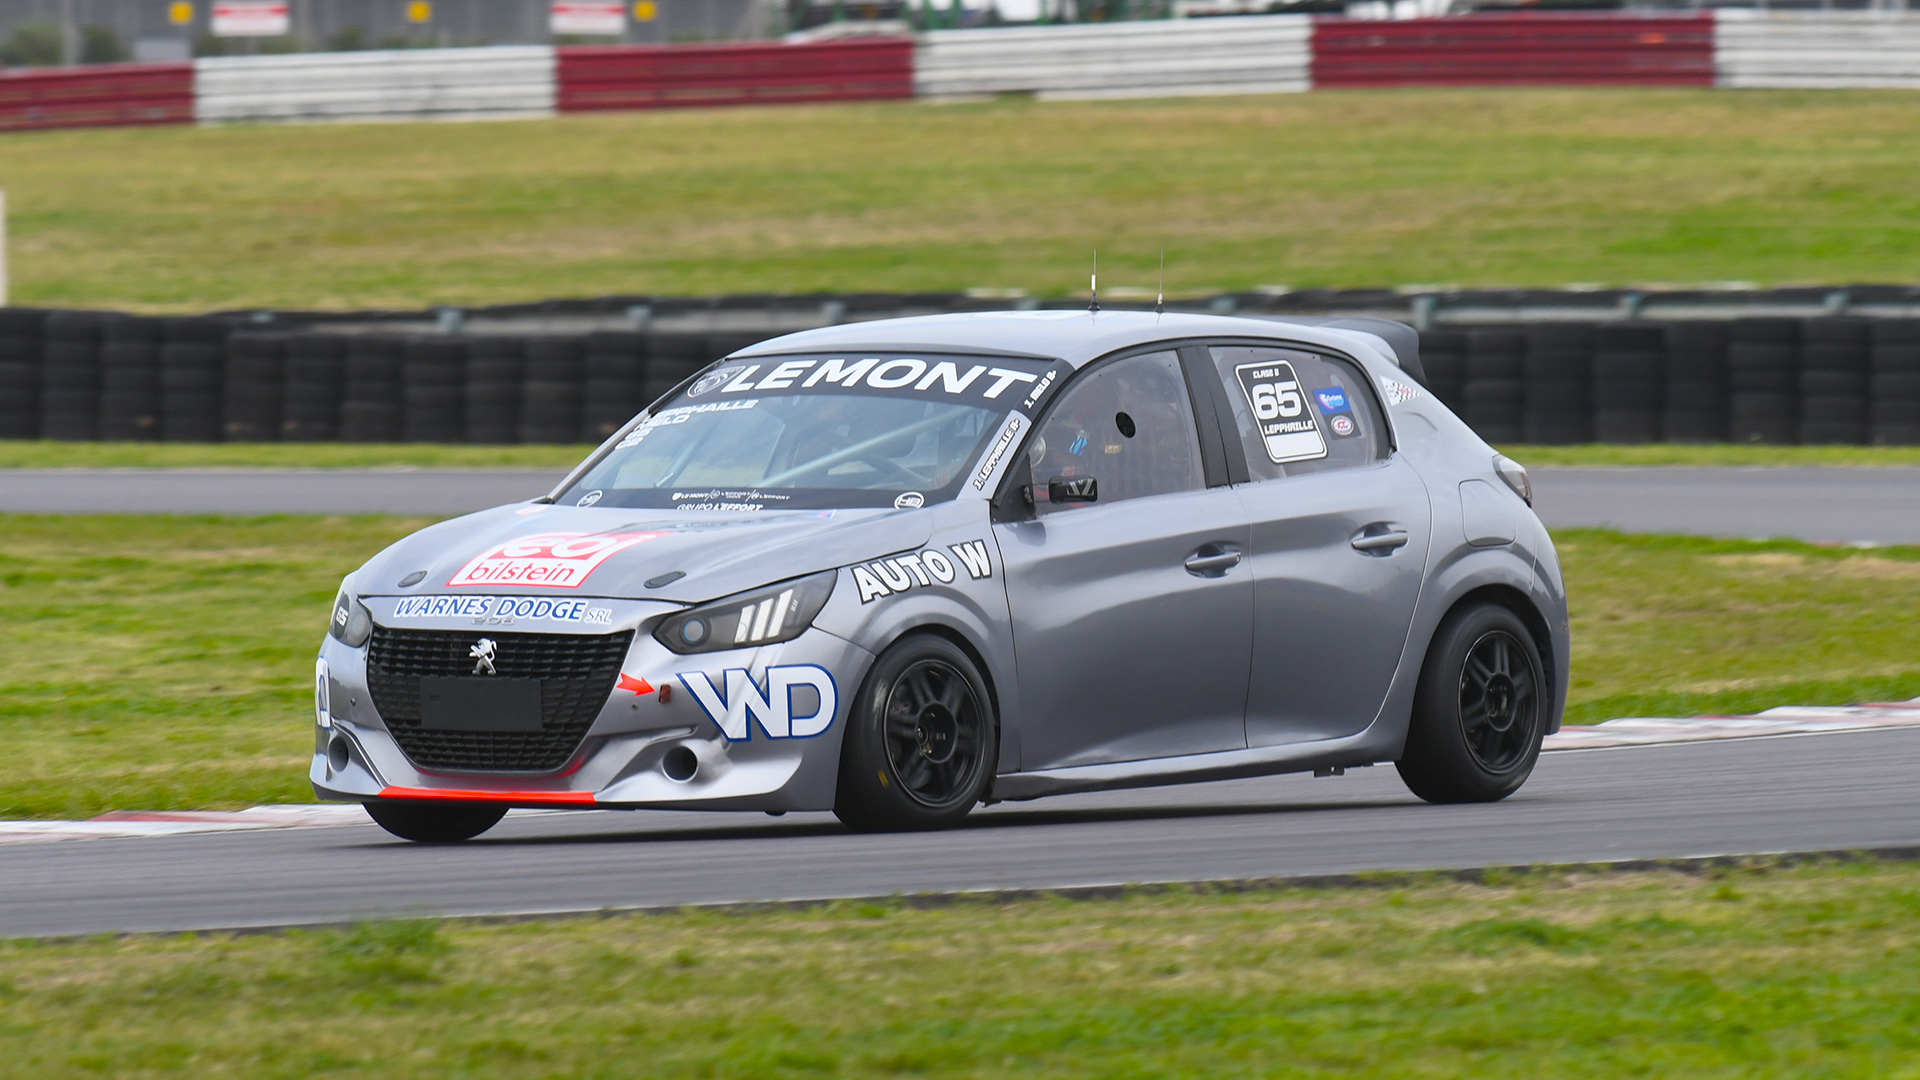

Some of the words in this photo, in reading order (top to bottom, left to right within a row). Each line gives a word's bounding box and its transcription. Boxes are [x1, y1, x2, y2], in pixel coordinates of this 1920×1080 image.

[721, 359, 1037, 398] LEMONT
[1252, 381, 1302, 420] 65
[1264, 420, 1314, 435] LEPPHAILLE
[465, 561, 575, 582] bilstein
[849, 549, 955, 605] AUTO
[948, 538, 993, 580] W
[395, 597, 494, 617] WARNES
[495, 599, 587, 621] DODGE
[586, 608, 612, 623] SRL
[676, 663, 838, 742] WD
